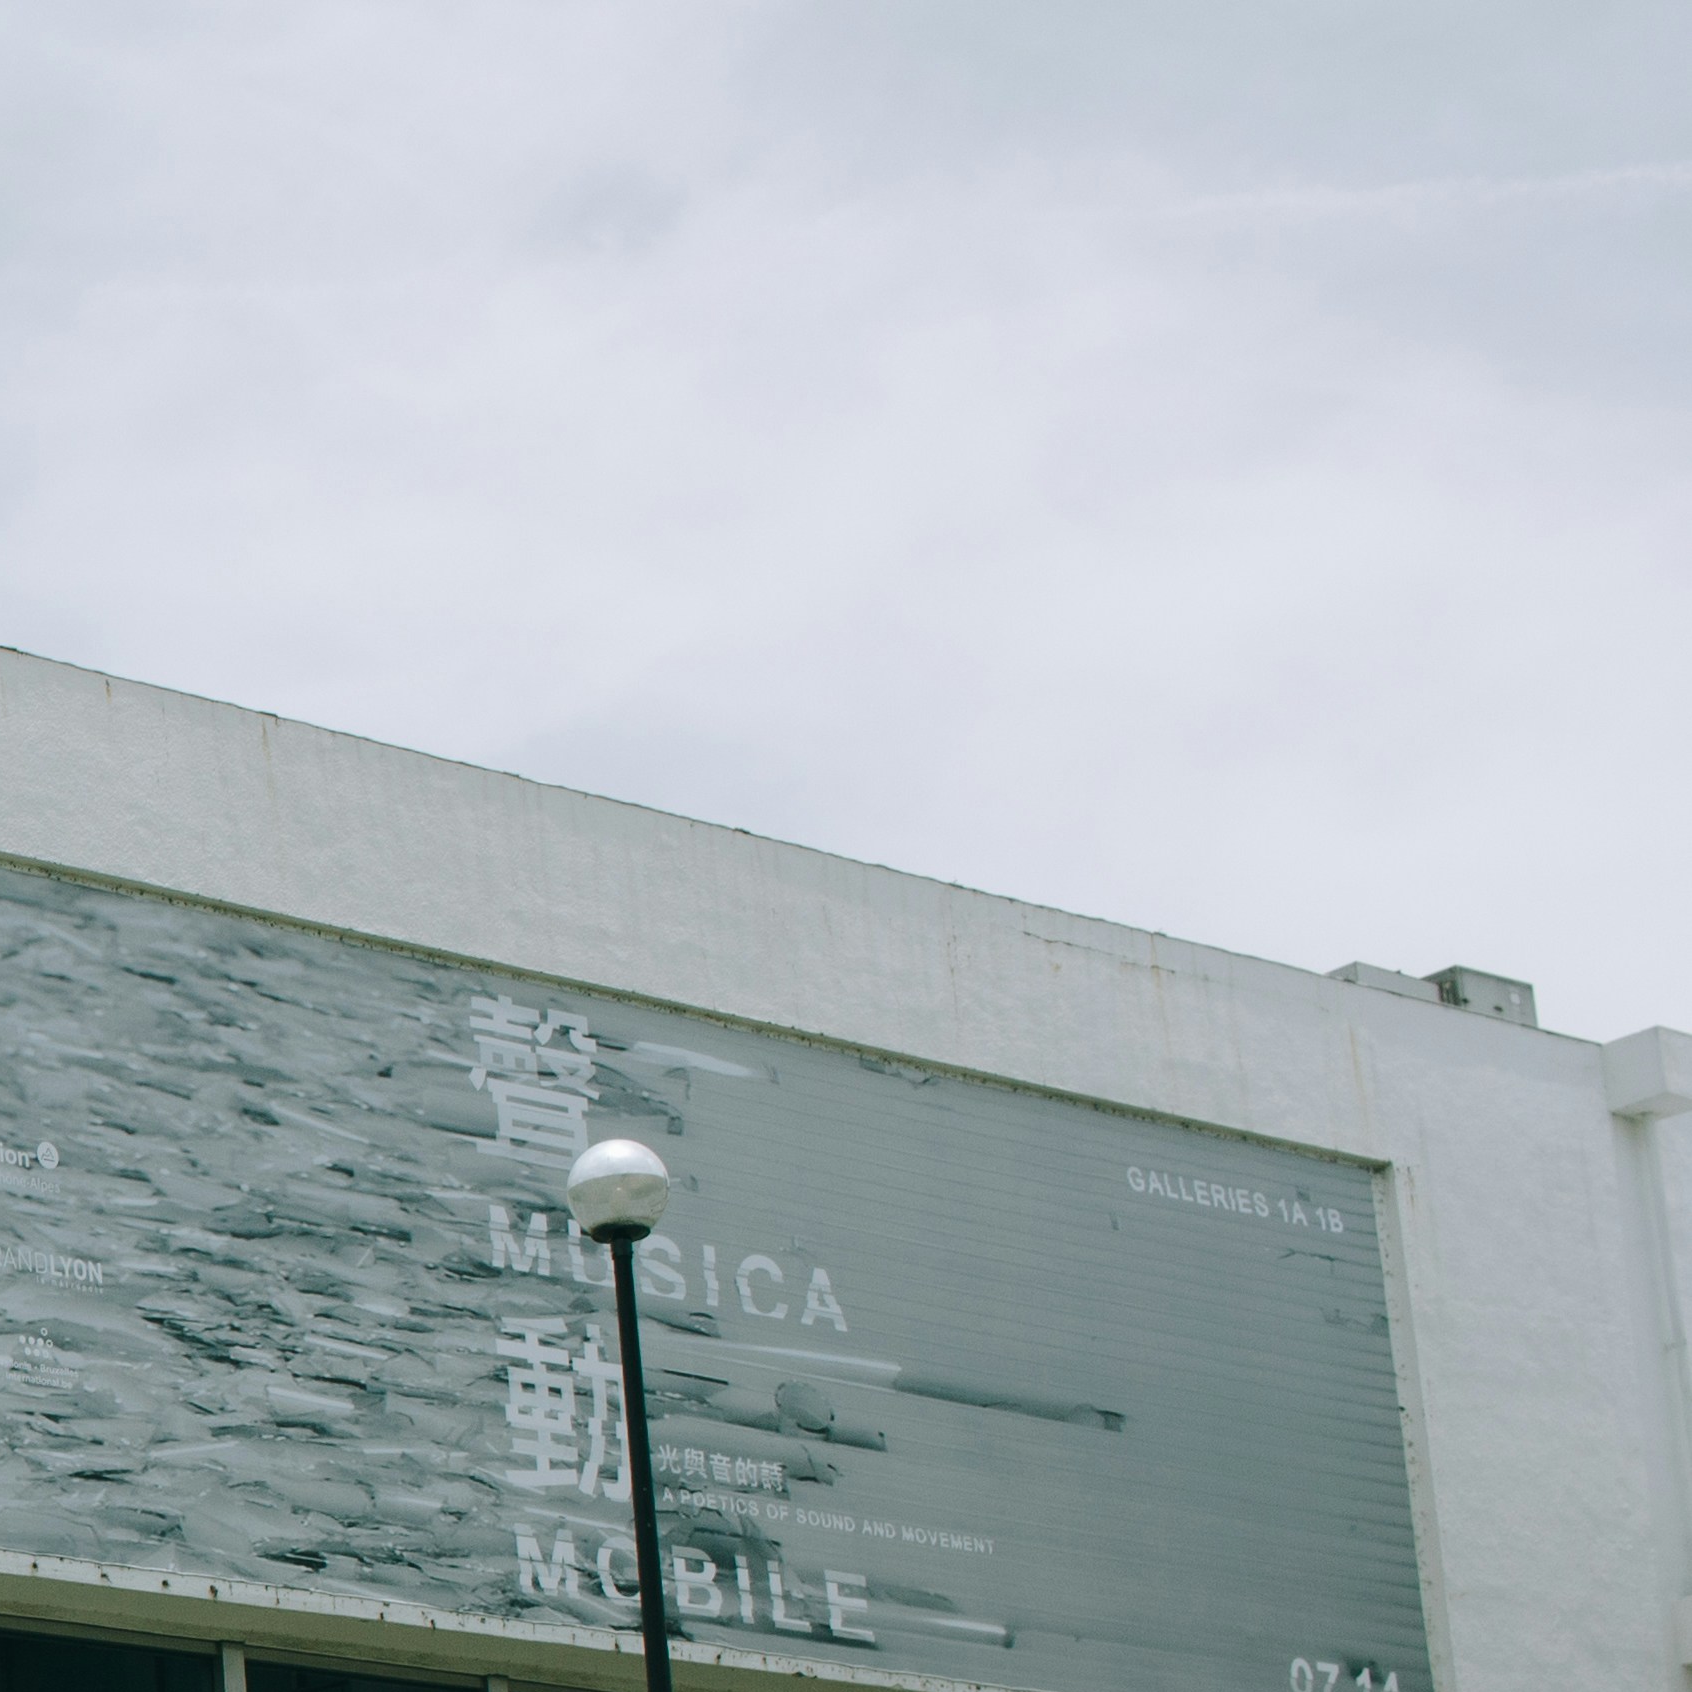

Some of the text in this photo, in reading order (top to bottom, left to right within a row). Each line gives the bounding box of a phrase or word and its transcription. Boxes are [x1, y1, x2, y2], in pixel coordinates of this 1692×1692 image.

[1126, 1165, 1345, 1234] GALLERIES 1A 1B
[489, 1203, 849, 1333] MUSICA
[39, 1363, 79, 1378] Bruxelles
[495, 1314, 634, 1503] 動
[658, 1443, 785, 1492] 光與音的詩
[662, 1486, 996, 1555] A POETICS OF SOUND AND MOVEMENT
[514, 1522, 876, 1643] MOBILE
